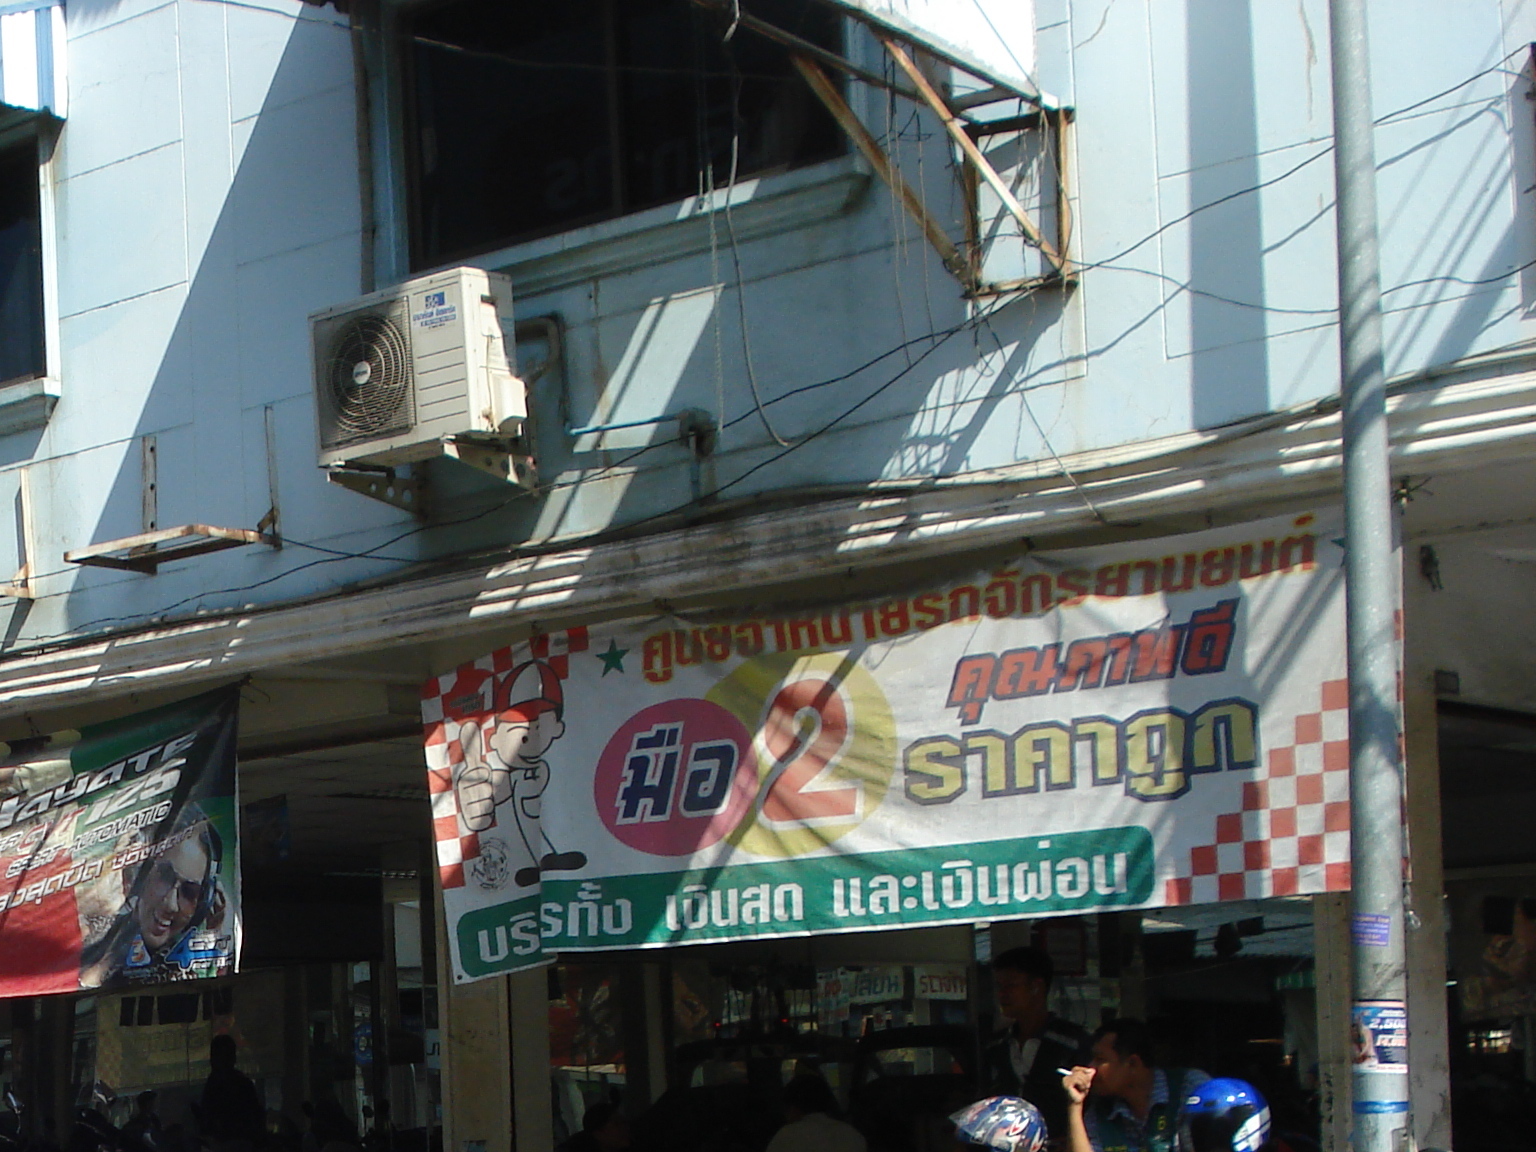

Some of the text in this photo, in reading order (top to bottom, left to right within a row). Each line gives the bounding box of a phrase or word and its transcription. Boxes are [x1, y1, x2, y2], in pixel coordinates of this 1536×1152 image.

[83, 757, 188, 827] 125
[615, 670, 866, 832] มือ 2
[902, 696, 1260, 806] ราคาถูก
[665, 880, 804, 933] เงินสด
[831, 838, 1130, 919] และเงินผ่อน
